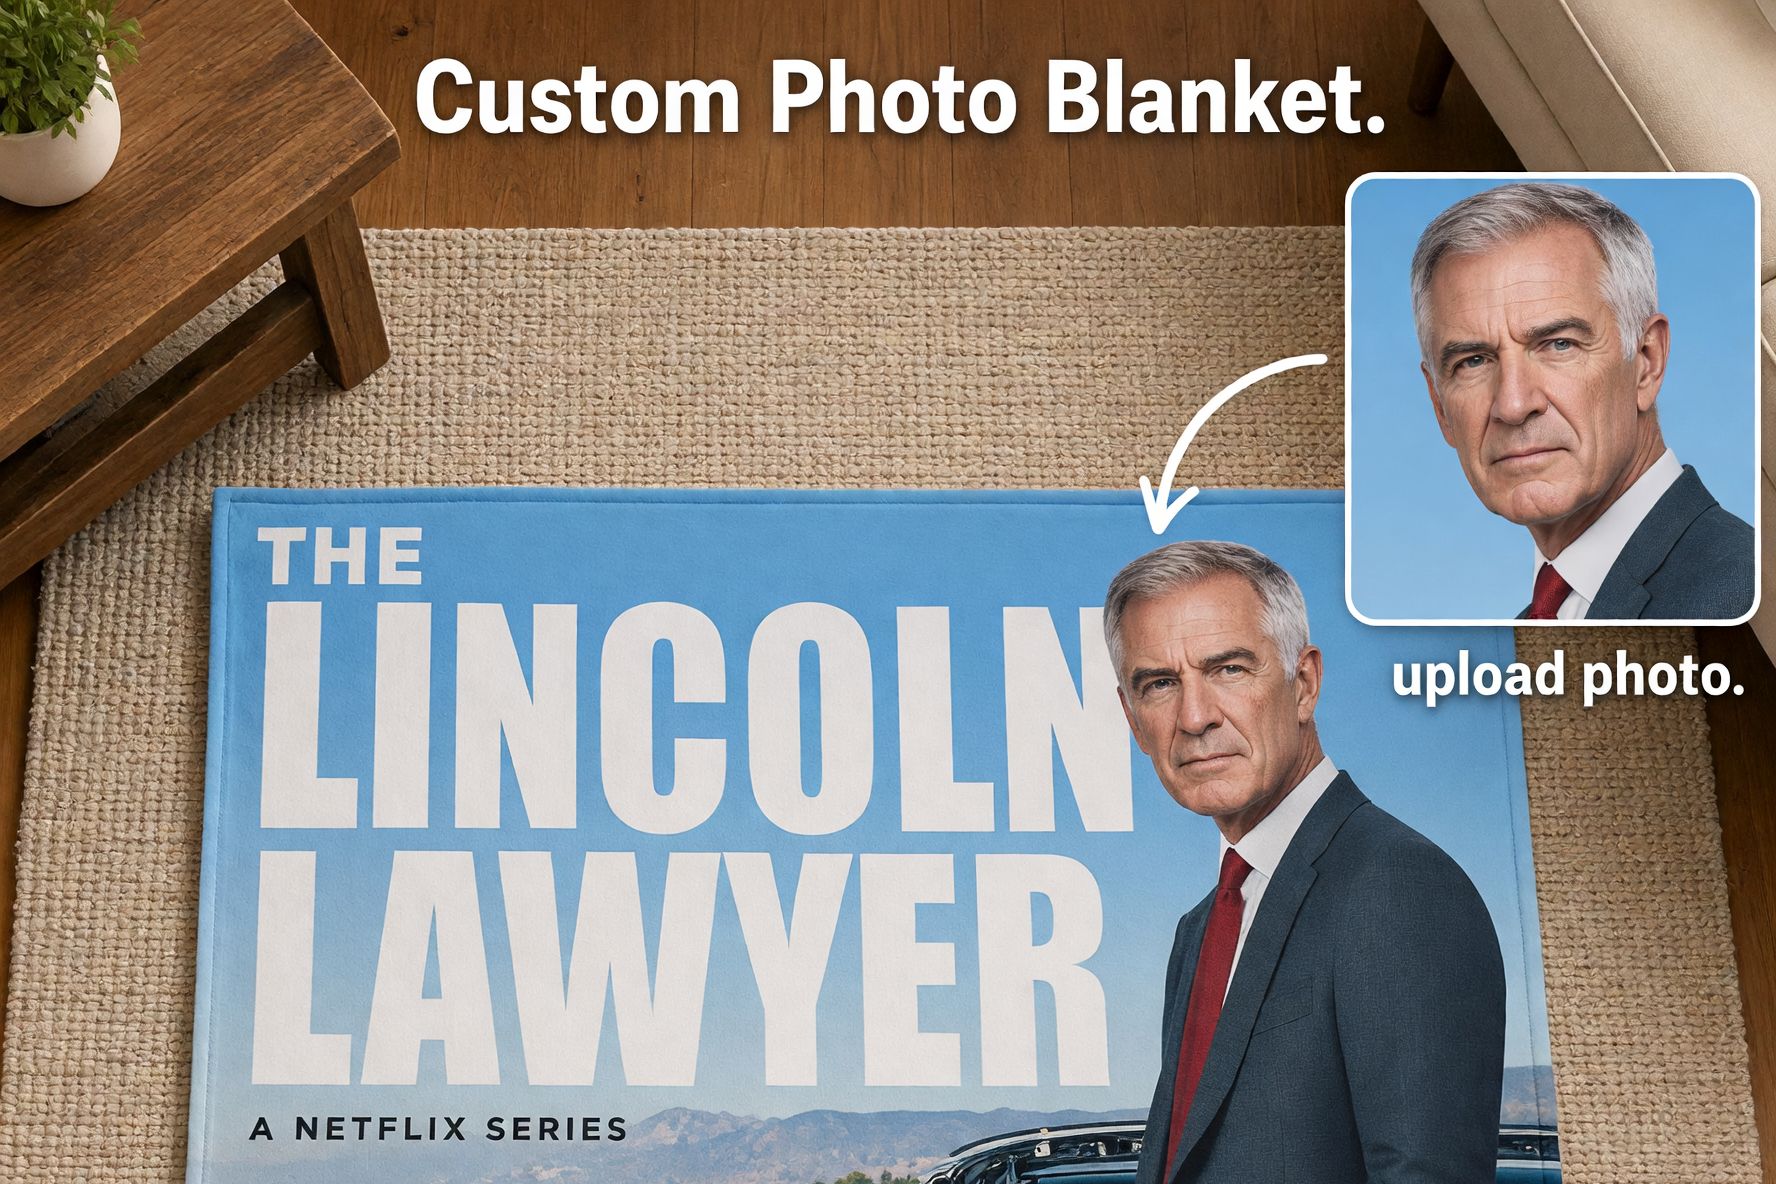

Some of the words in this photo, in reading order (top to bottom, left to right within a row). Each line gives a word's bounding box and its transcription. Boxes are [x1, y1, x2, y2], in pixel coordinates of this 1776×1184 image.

[257, 527, 422, 585] THE
[259, 601, 1135, 836] LINCOLN
[251, 850, 1110, 1087] LAWYER
[248, 1115, 274, 1142] A
[294, 1115, 467, 1142] NETFLIX
[485, 1115, 627, 1142] SERIES
